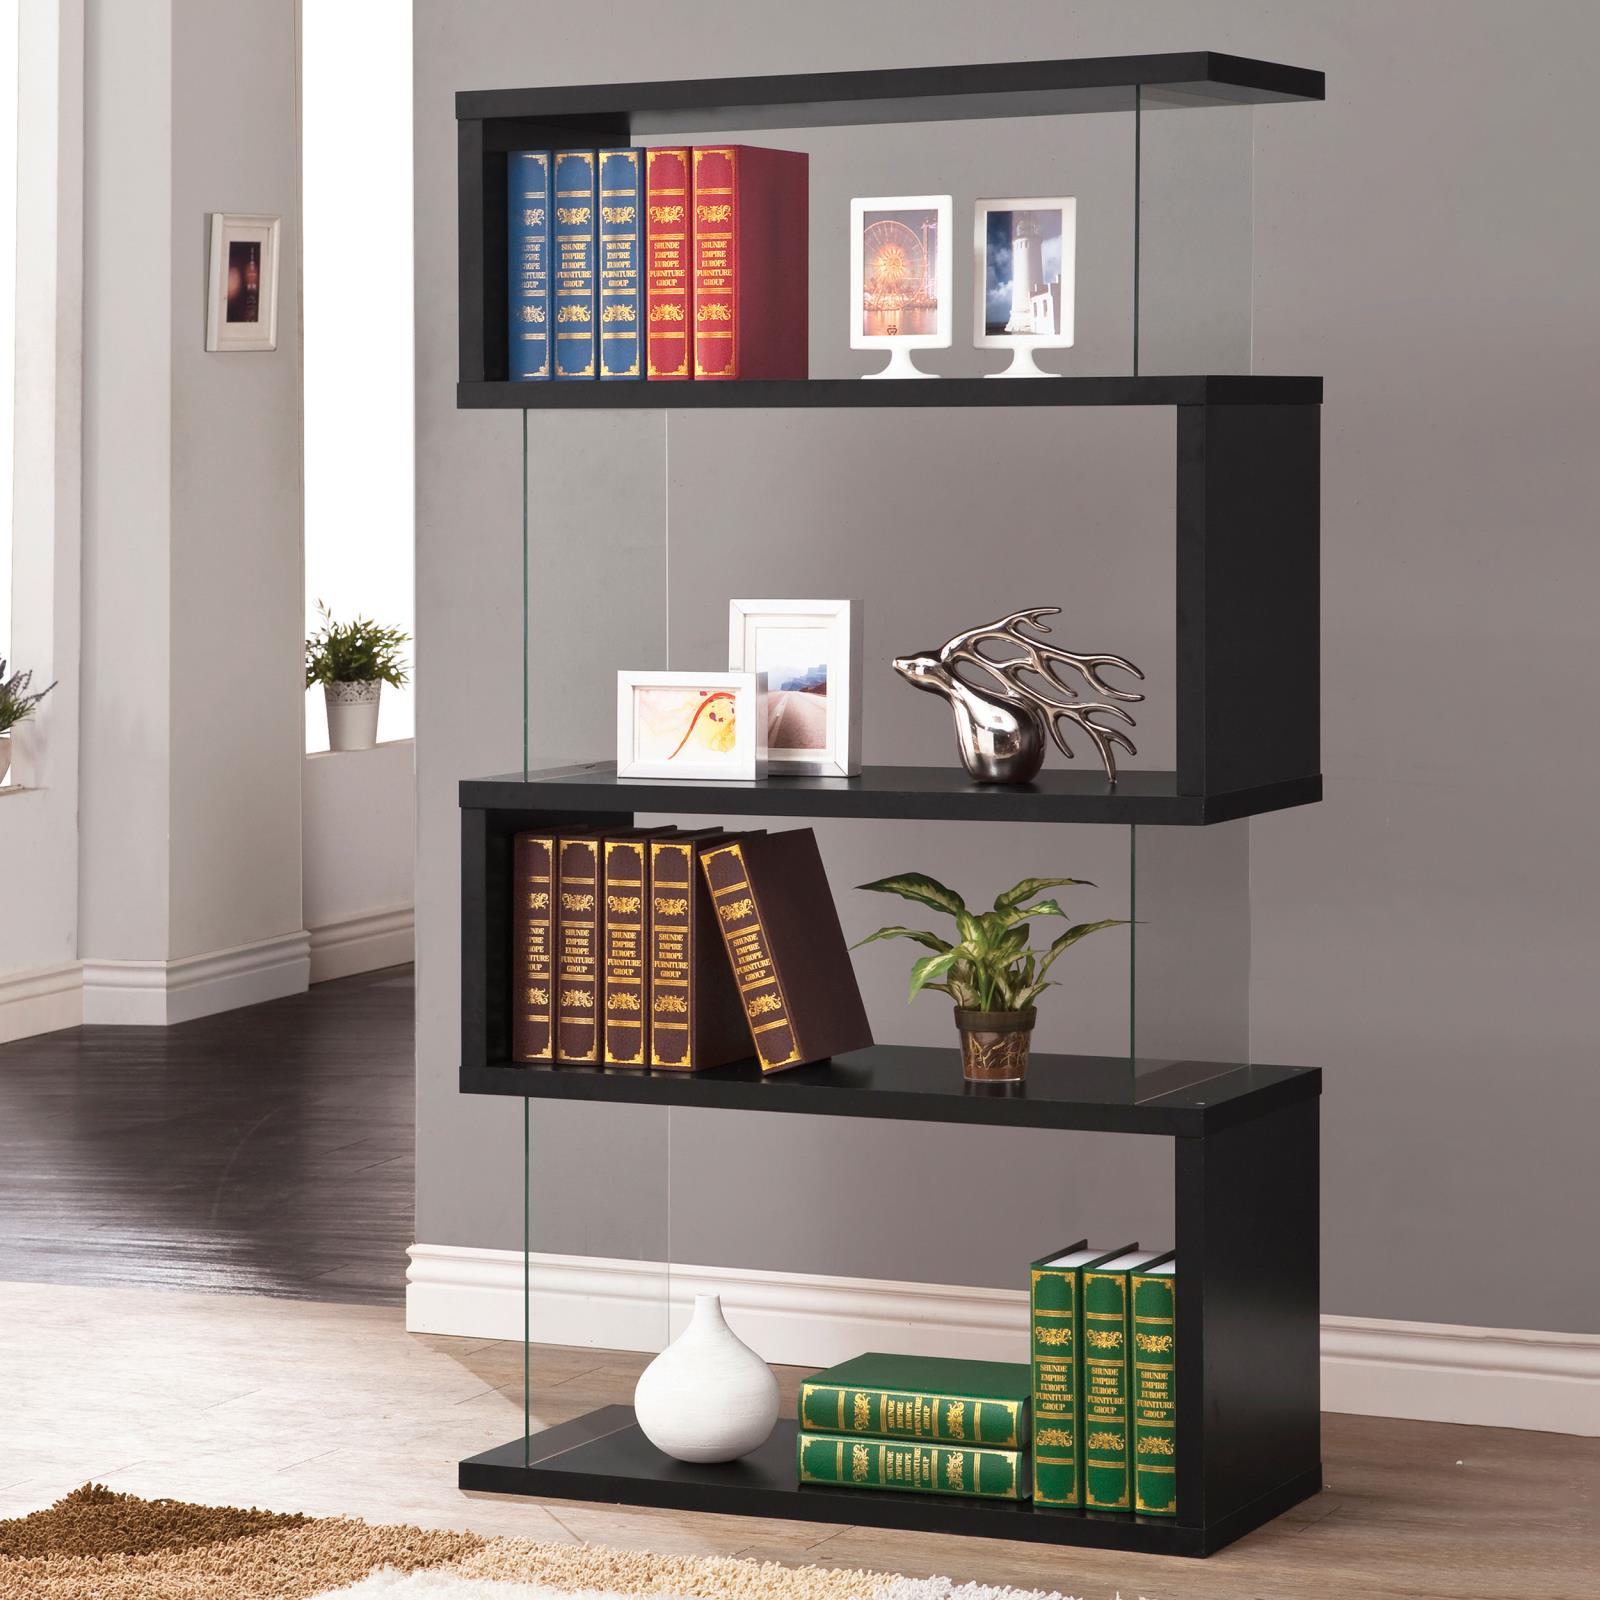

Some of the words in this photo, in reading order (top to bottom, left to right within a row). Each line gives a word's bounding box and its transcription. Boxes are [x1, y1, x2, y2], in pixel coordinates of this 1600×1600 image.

[656, 278, 677, 286] GROUP
[567, 965, 587, 973] GROUP
[614, 968, 634, 976] GROUP
[660, 970, 681, 978] GROUP
[1042, 1403, 1066, 1411] GROUP
[1094, 1406, 1116, 1414] GROUP
[1143, 1410, 1166, 1418] GROUP
